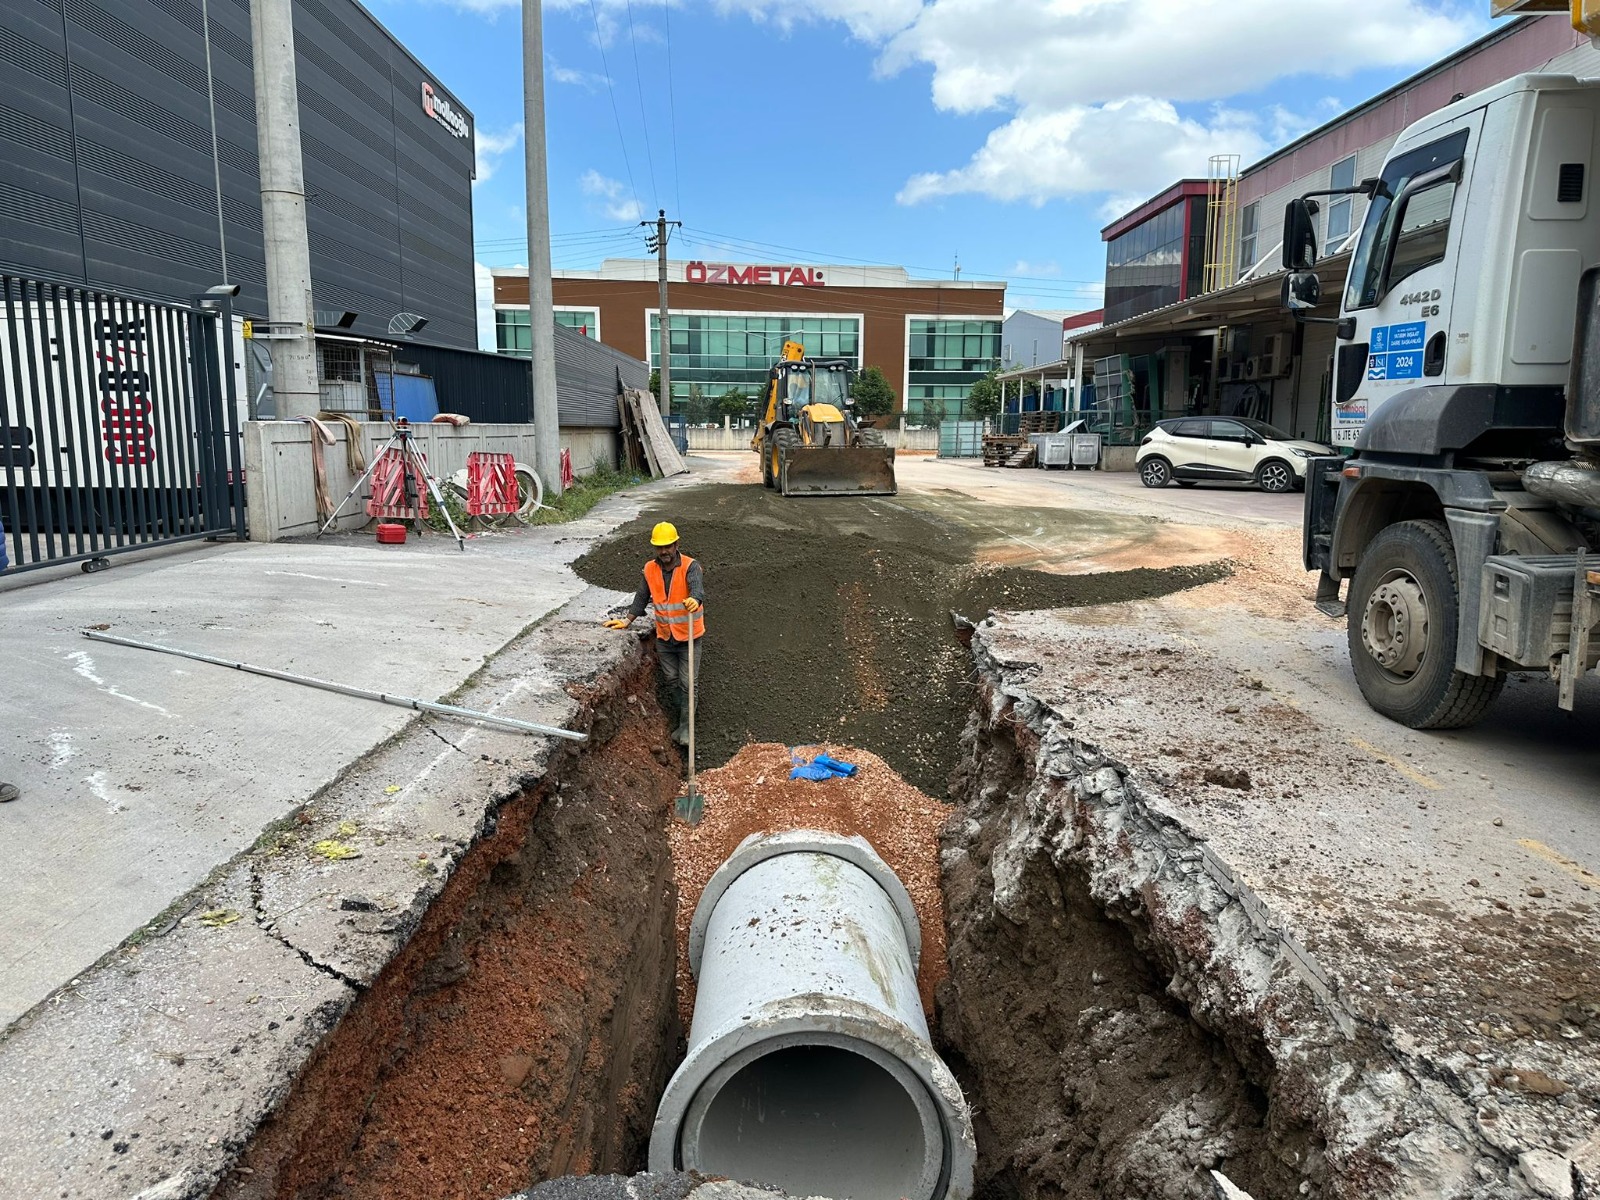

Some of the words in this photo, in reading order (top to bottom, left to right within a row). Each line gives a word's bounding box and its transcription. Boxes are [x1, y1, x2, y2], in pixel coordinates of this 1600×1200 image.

[686, 260, 825, 286] ÖZMETAL
[1400, 289, 1441, 305] 4142D
[1421, 304, 1440, 317] E6
[1395, 356, 1414, 368] 2024
